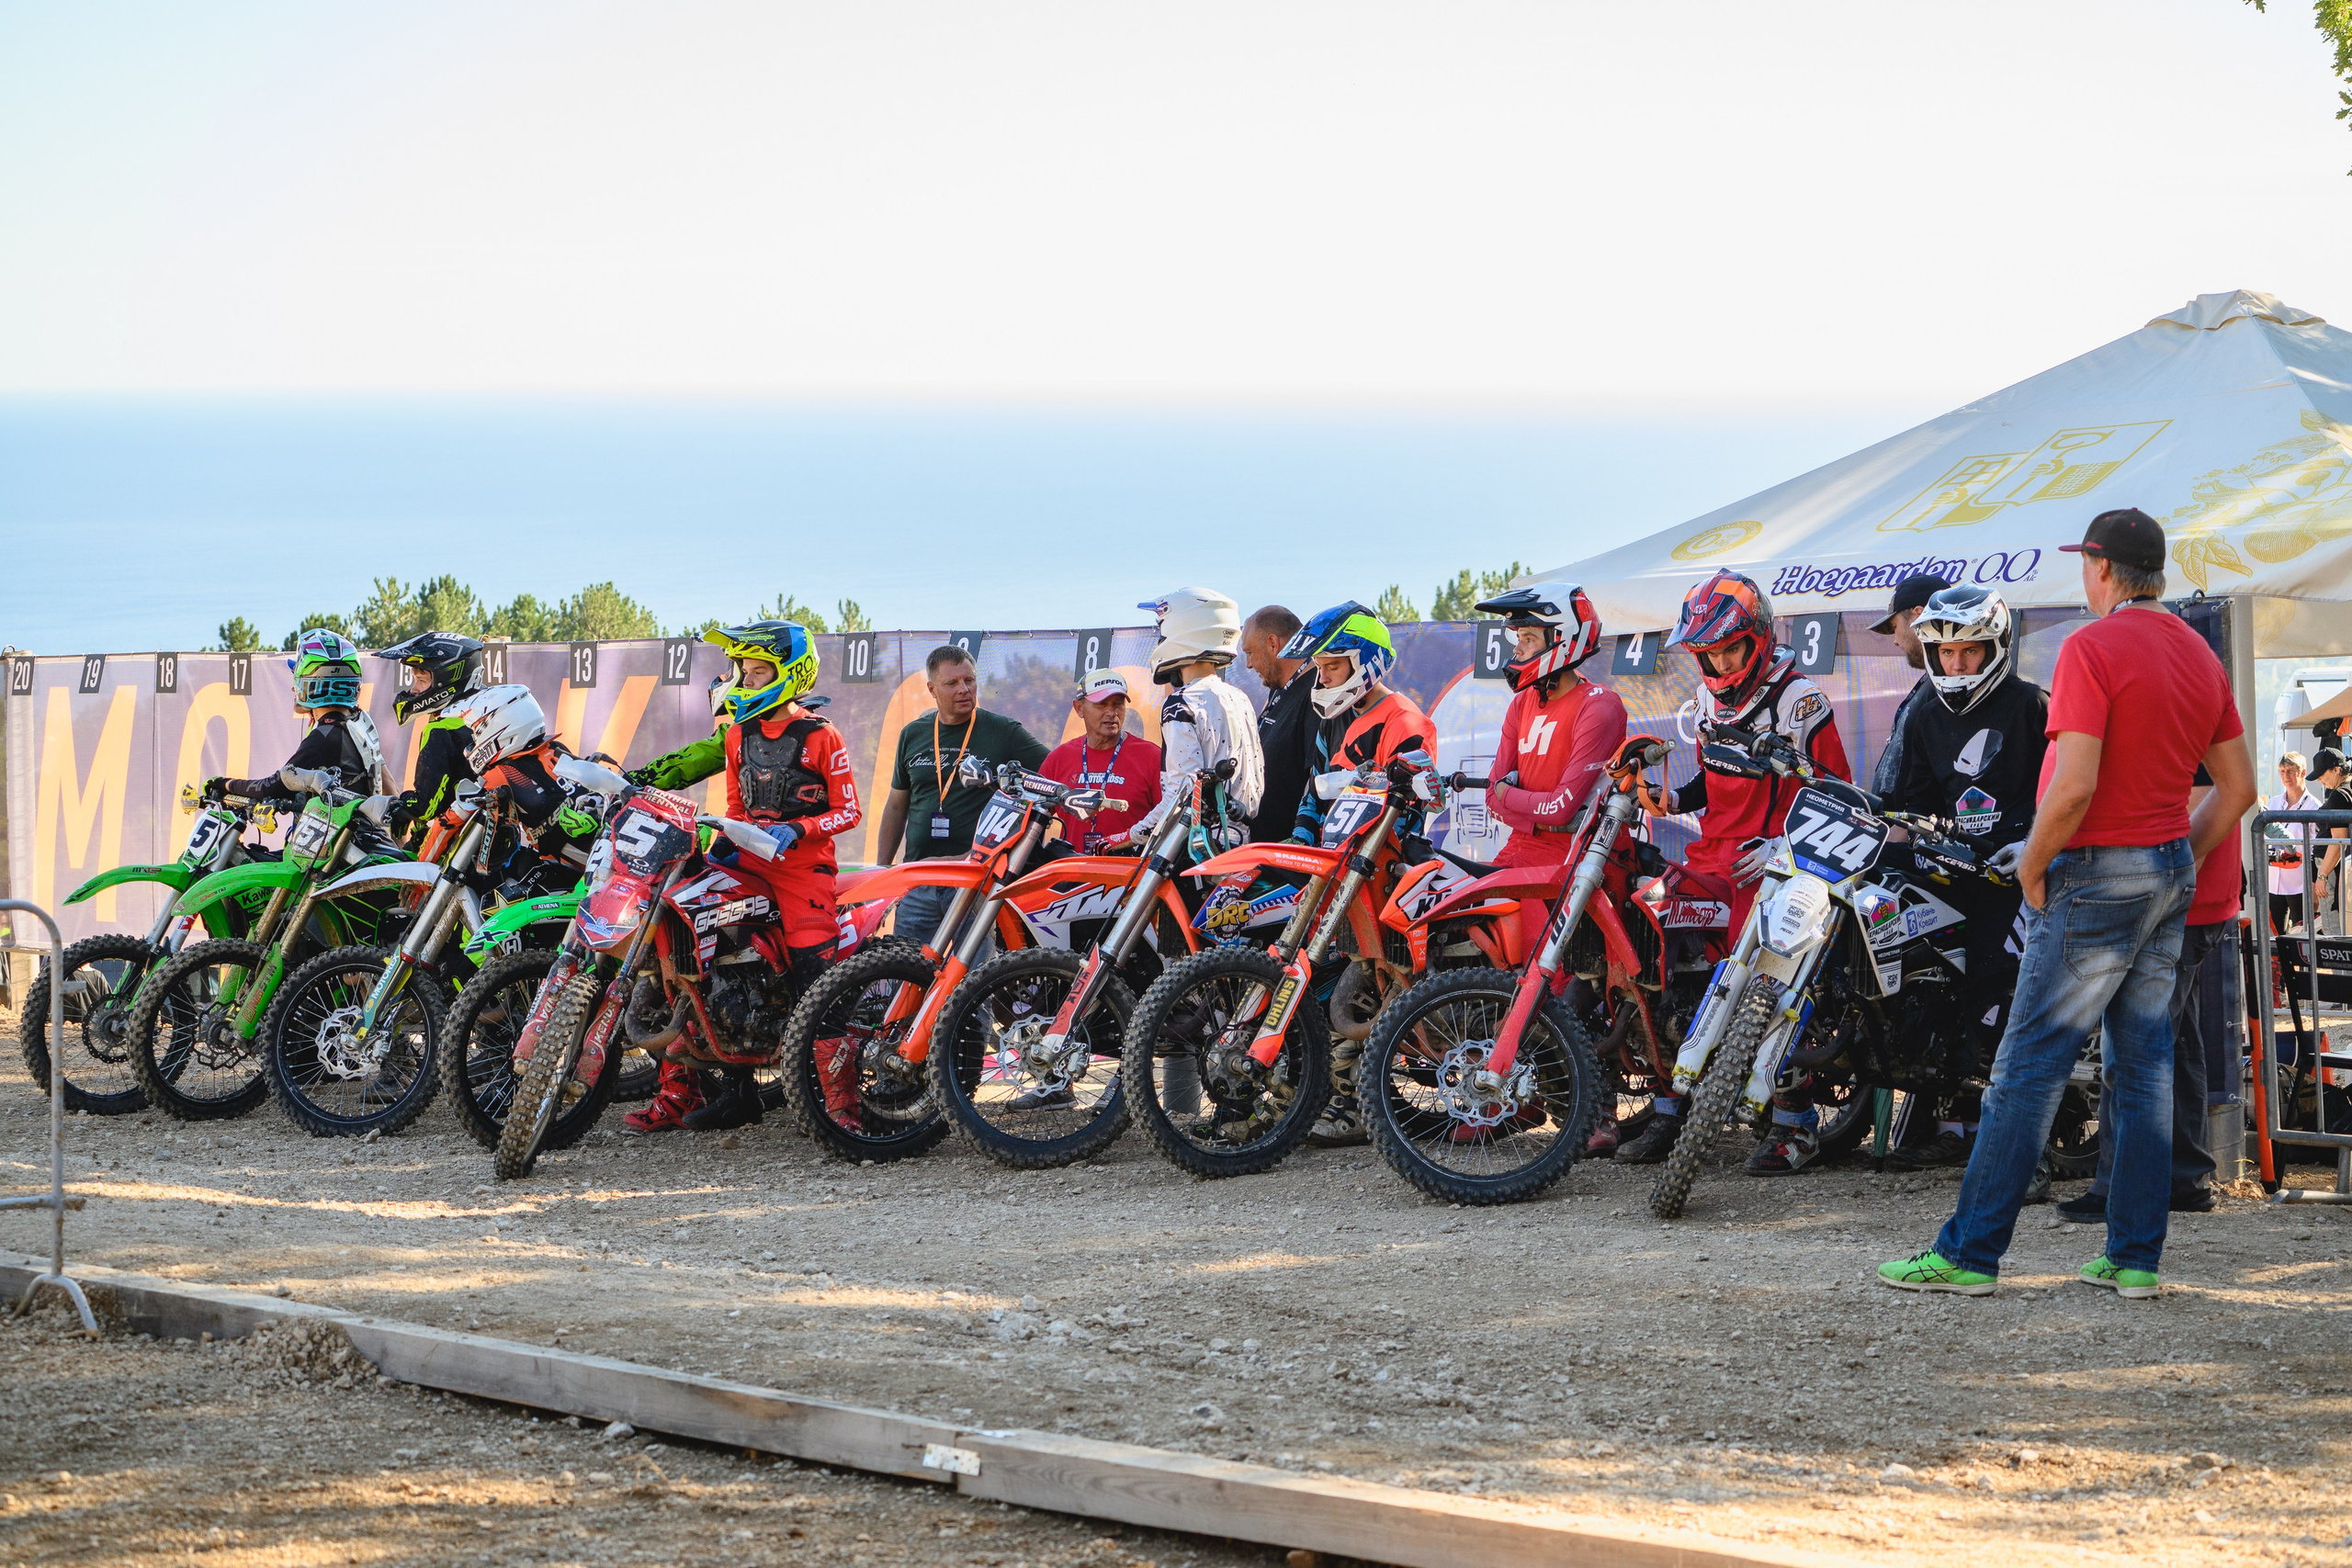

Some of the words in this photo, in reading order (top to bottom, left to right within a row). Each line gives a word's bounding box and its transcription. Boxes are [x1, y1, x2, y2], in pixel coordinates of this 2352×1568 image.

[849, 639, 868, 676] 10
[1085, 636, 1100, 672] 8
[1486, 628, 1502, 671] 5
[1624, 633, 1644, 666] 4
[1802, 620, 1822, 667] 3
[14, 659, 30, 691] 20
[85, 659, 101, 690] 19
[160, 657, 175, 689] 18
[232, 659, 248, 689] 17
[485, 650, 503, 683] 14
[573, 649, 593, 682] 13
[668, 643, 686, 680] 12
[1094, 679, 1124, 687] REPSOL
[1702, 757, 1742, 773] ACERBIS
[647, 787, 694, 807] RENTHAL
[1023, 781, 1056, 793] RENTHAL
[1533, 788, 1574, 815] JUST1
[1805, 793, 1846, 813] НЕОМЕТРИЯ
[190, 819, 217, 848] 5
[977, 805, 1020, 842] 114
[1325, 801, 1369, 834] 51
[480, 818, 495, 865] SCOTT
[616, 811, 670, 858] 5
[1789, 807, 1880, 872] 744
[1283, 853, 1319, 863] KENDA
[1936, 855, 1976, 872] ACERBIS
[695, 895, 770, 934] GASGAS
[1206, 902, 1250, 929] DRC
[1870, 917, 1901, 937] КРАСНОДАРСКИ
[1917, 908, 1935, 919] Кубань
[1918, 916, 1939, 930] Кредит
[700, 933, 718, 945] KENDA
[372, 953, 401, 999] MOTOREX
